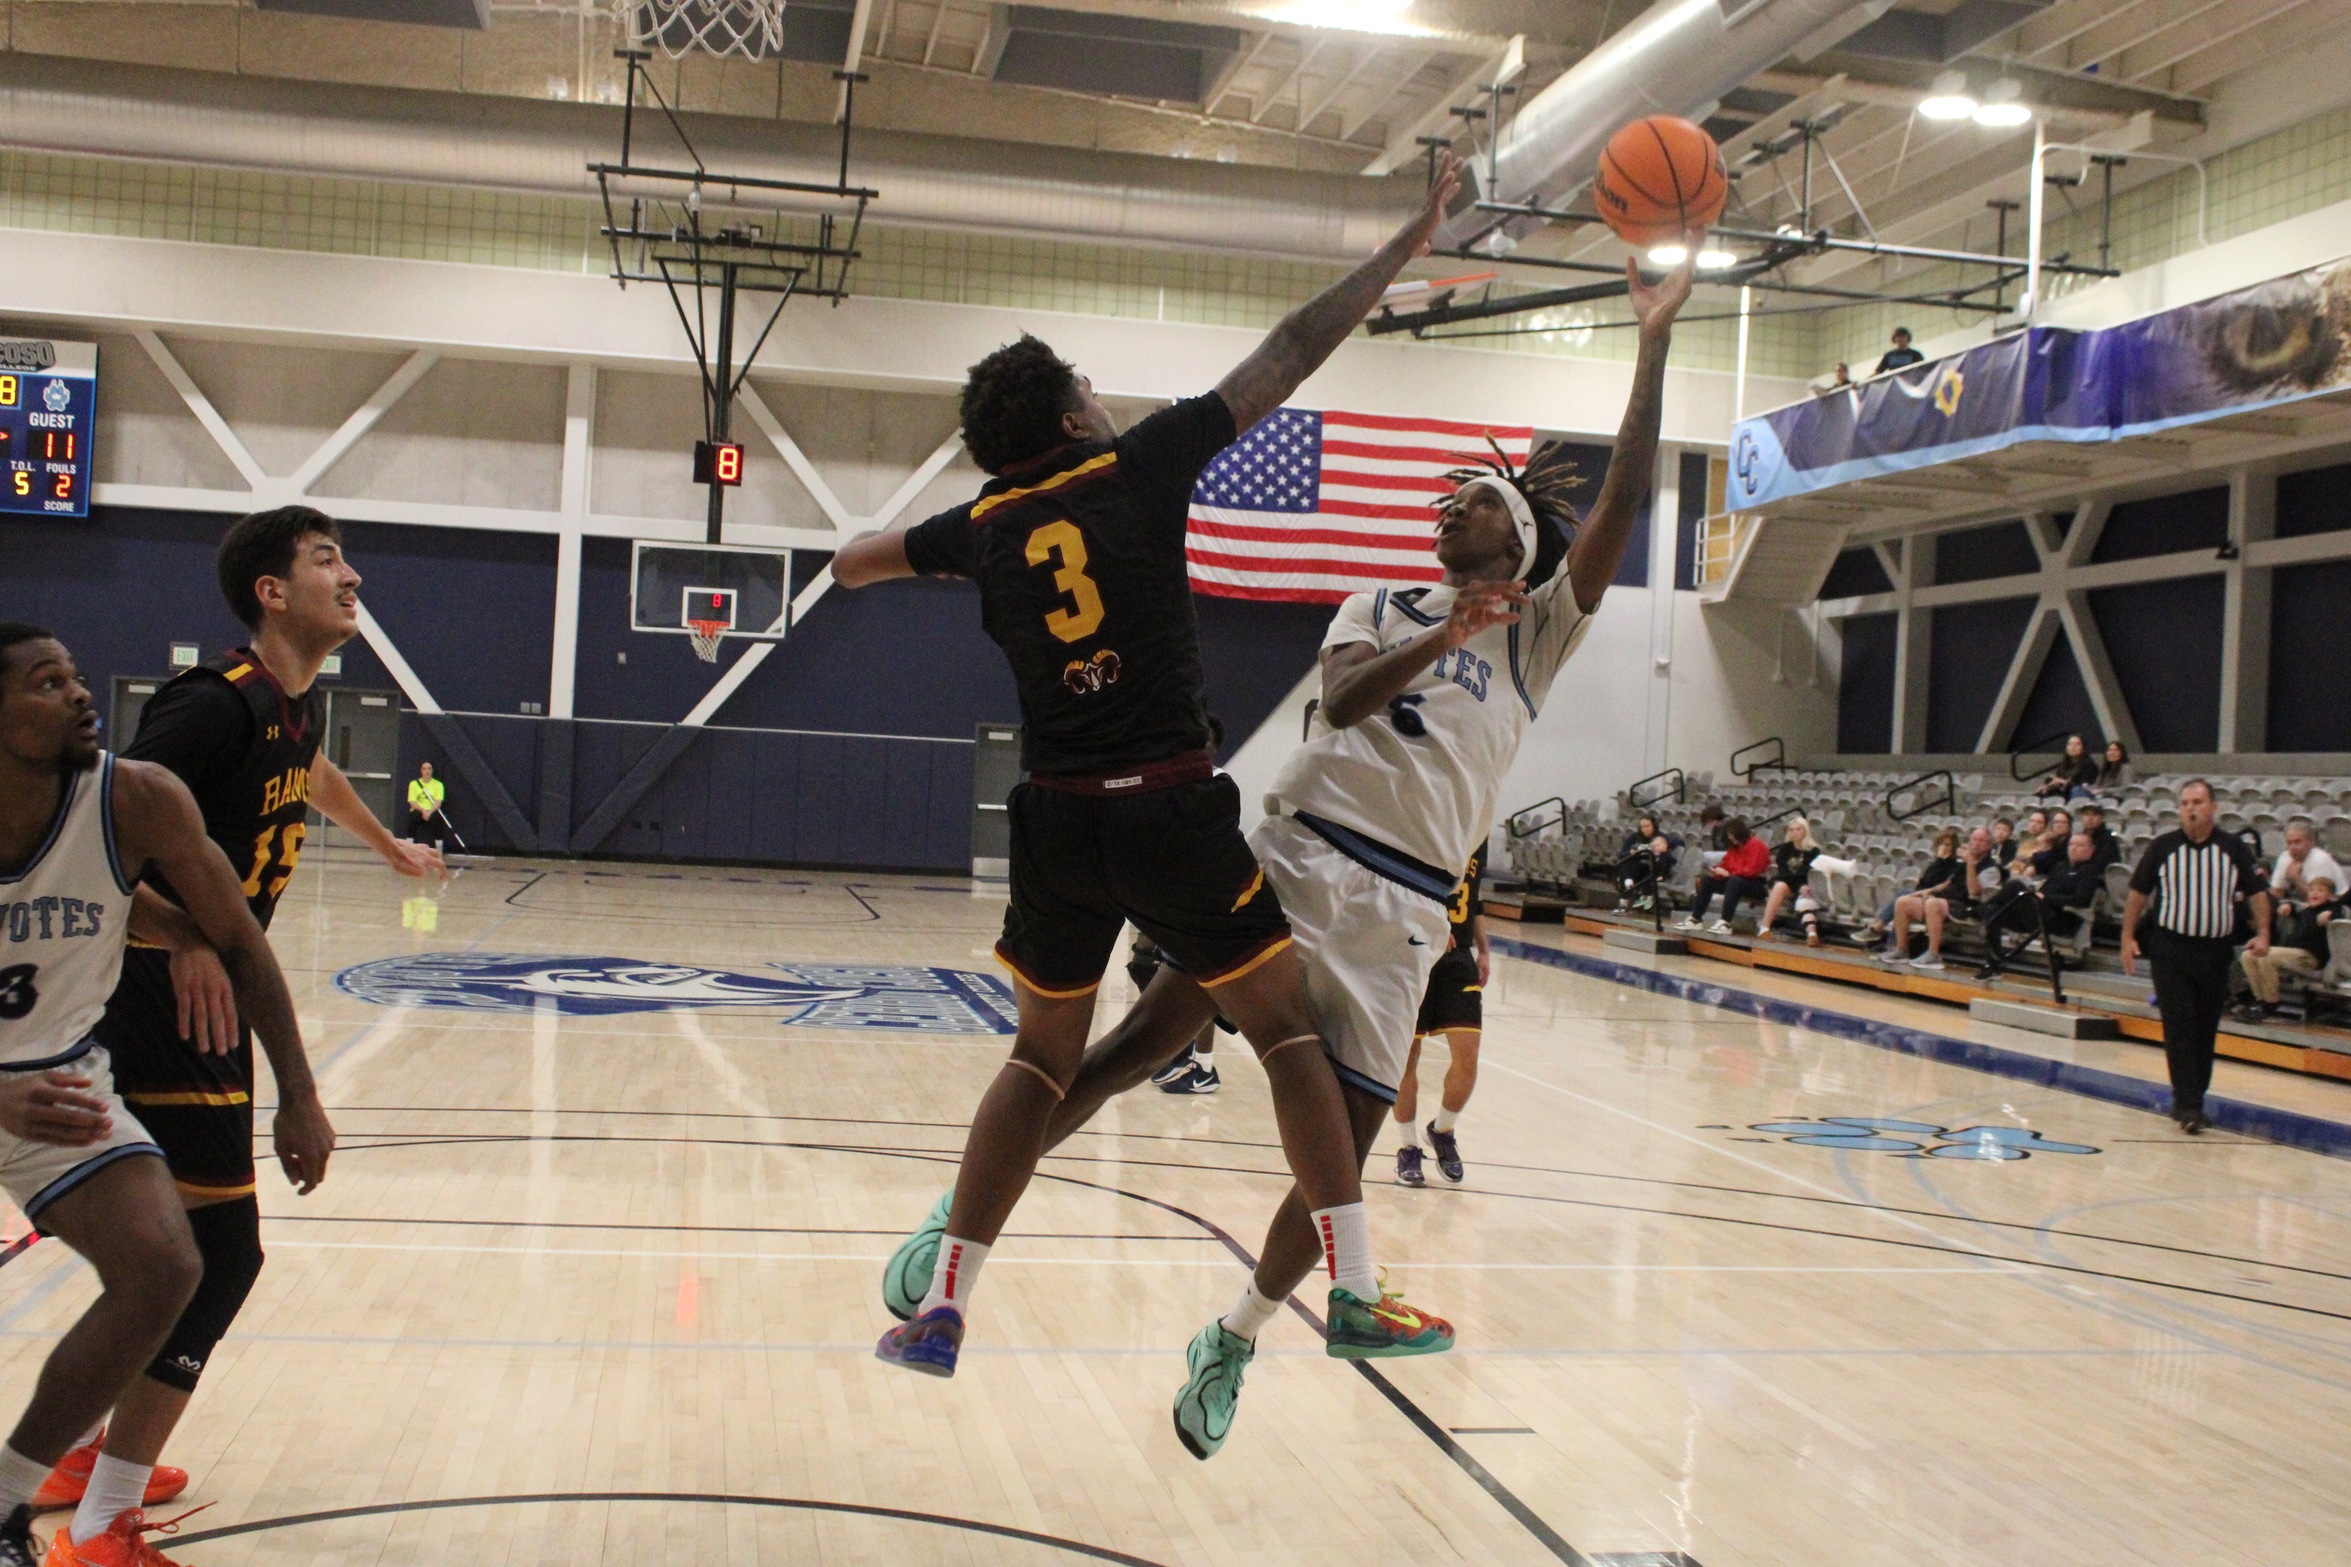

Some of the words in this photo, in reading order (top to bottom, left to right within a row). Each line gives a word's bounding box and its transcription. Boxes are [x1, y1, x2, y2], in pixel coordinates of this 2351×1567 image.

[0, 341, 56, 368] OSO
[29, 412, 75, 429] GUEST
[46, 432, 74, 460] 11
[45, 462, 77, 475] FOULS
[718, 447, 738, 479] 8
[55, 473, 71, 498] 2
[43, 500, 75, 513] SCORE
[1025, 519, 1105, 643] 3
